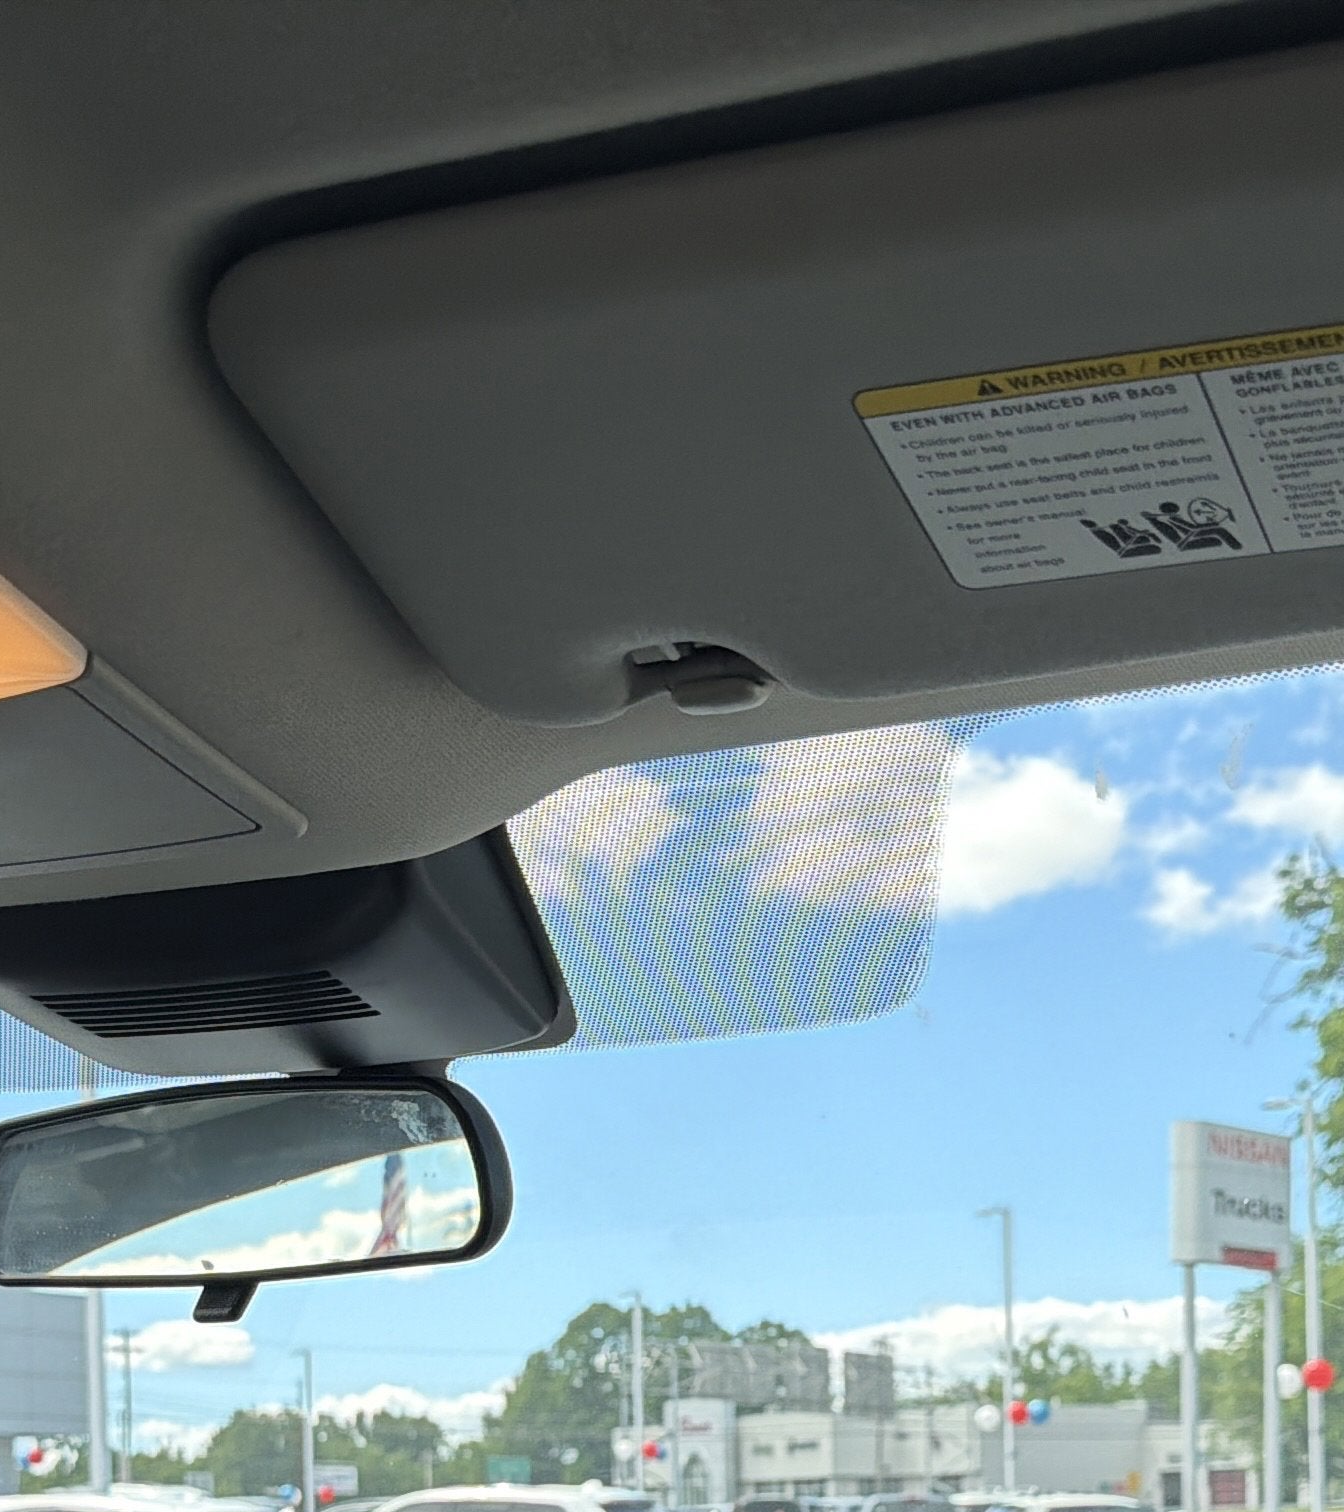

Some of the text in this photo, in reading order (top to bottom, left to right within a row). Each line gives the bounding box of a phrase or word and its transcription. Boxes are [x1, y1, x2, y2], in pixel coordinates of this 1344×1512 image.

[1006, 361, 1127, 391] WARNING
[1230, 368, 1283, 385] MÊME
[1291, 360, 1340, 376] AVEC
[889, 383, 1178, 431] EVEN WITH ADVANCED AIR BAGS
[968, 432, 993, 442] can
[995, 429, 1014, 438] be
[916, 454, 932, 463] by
